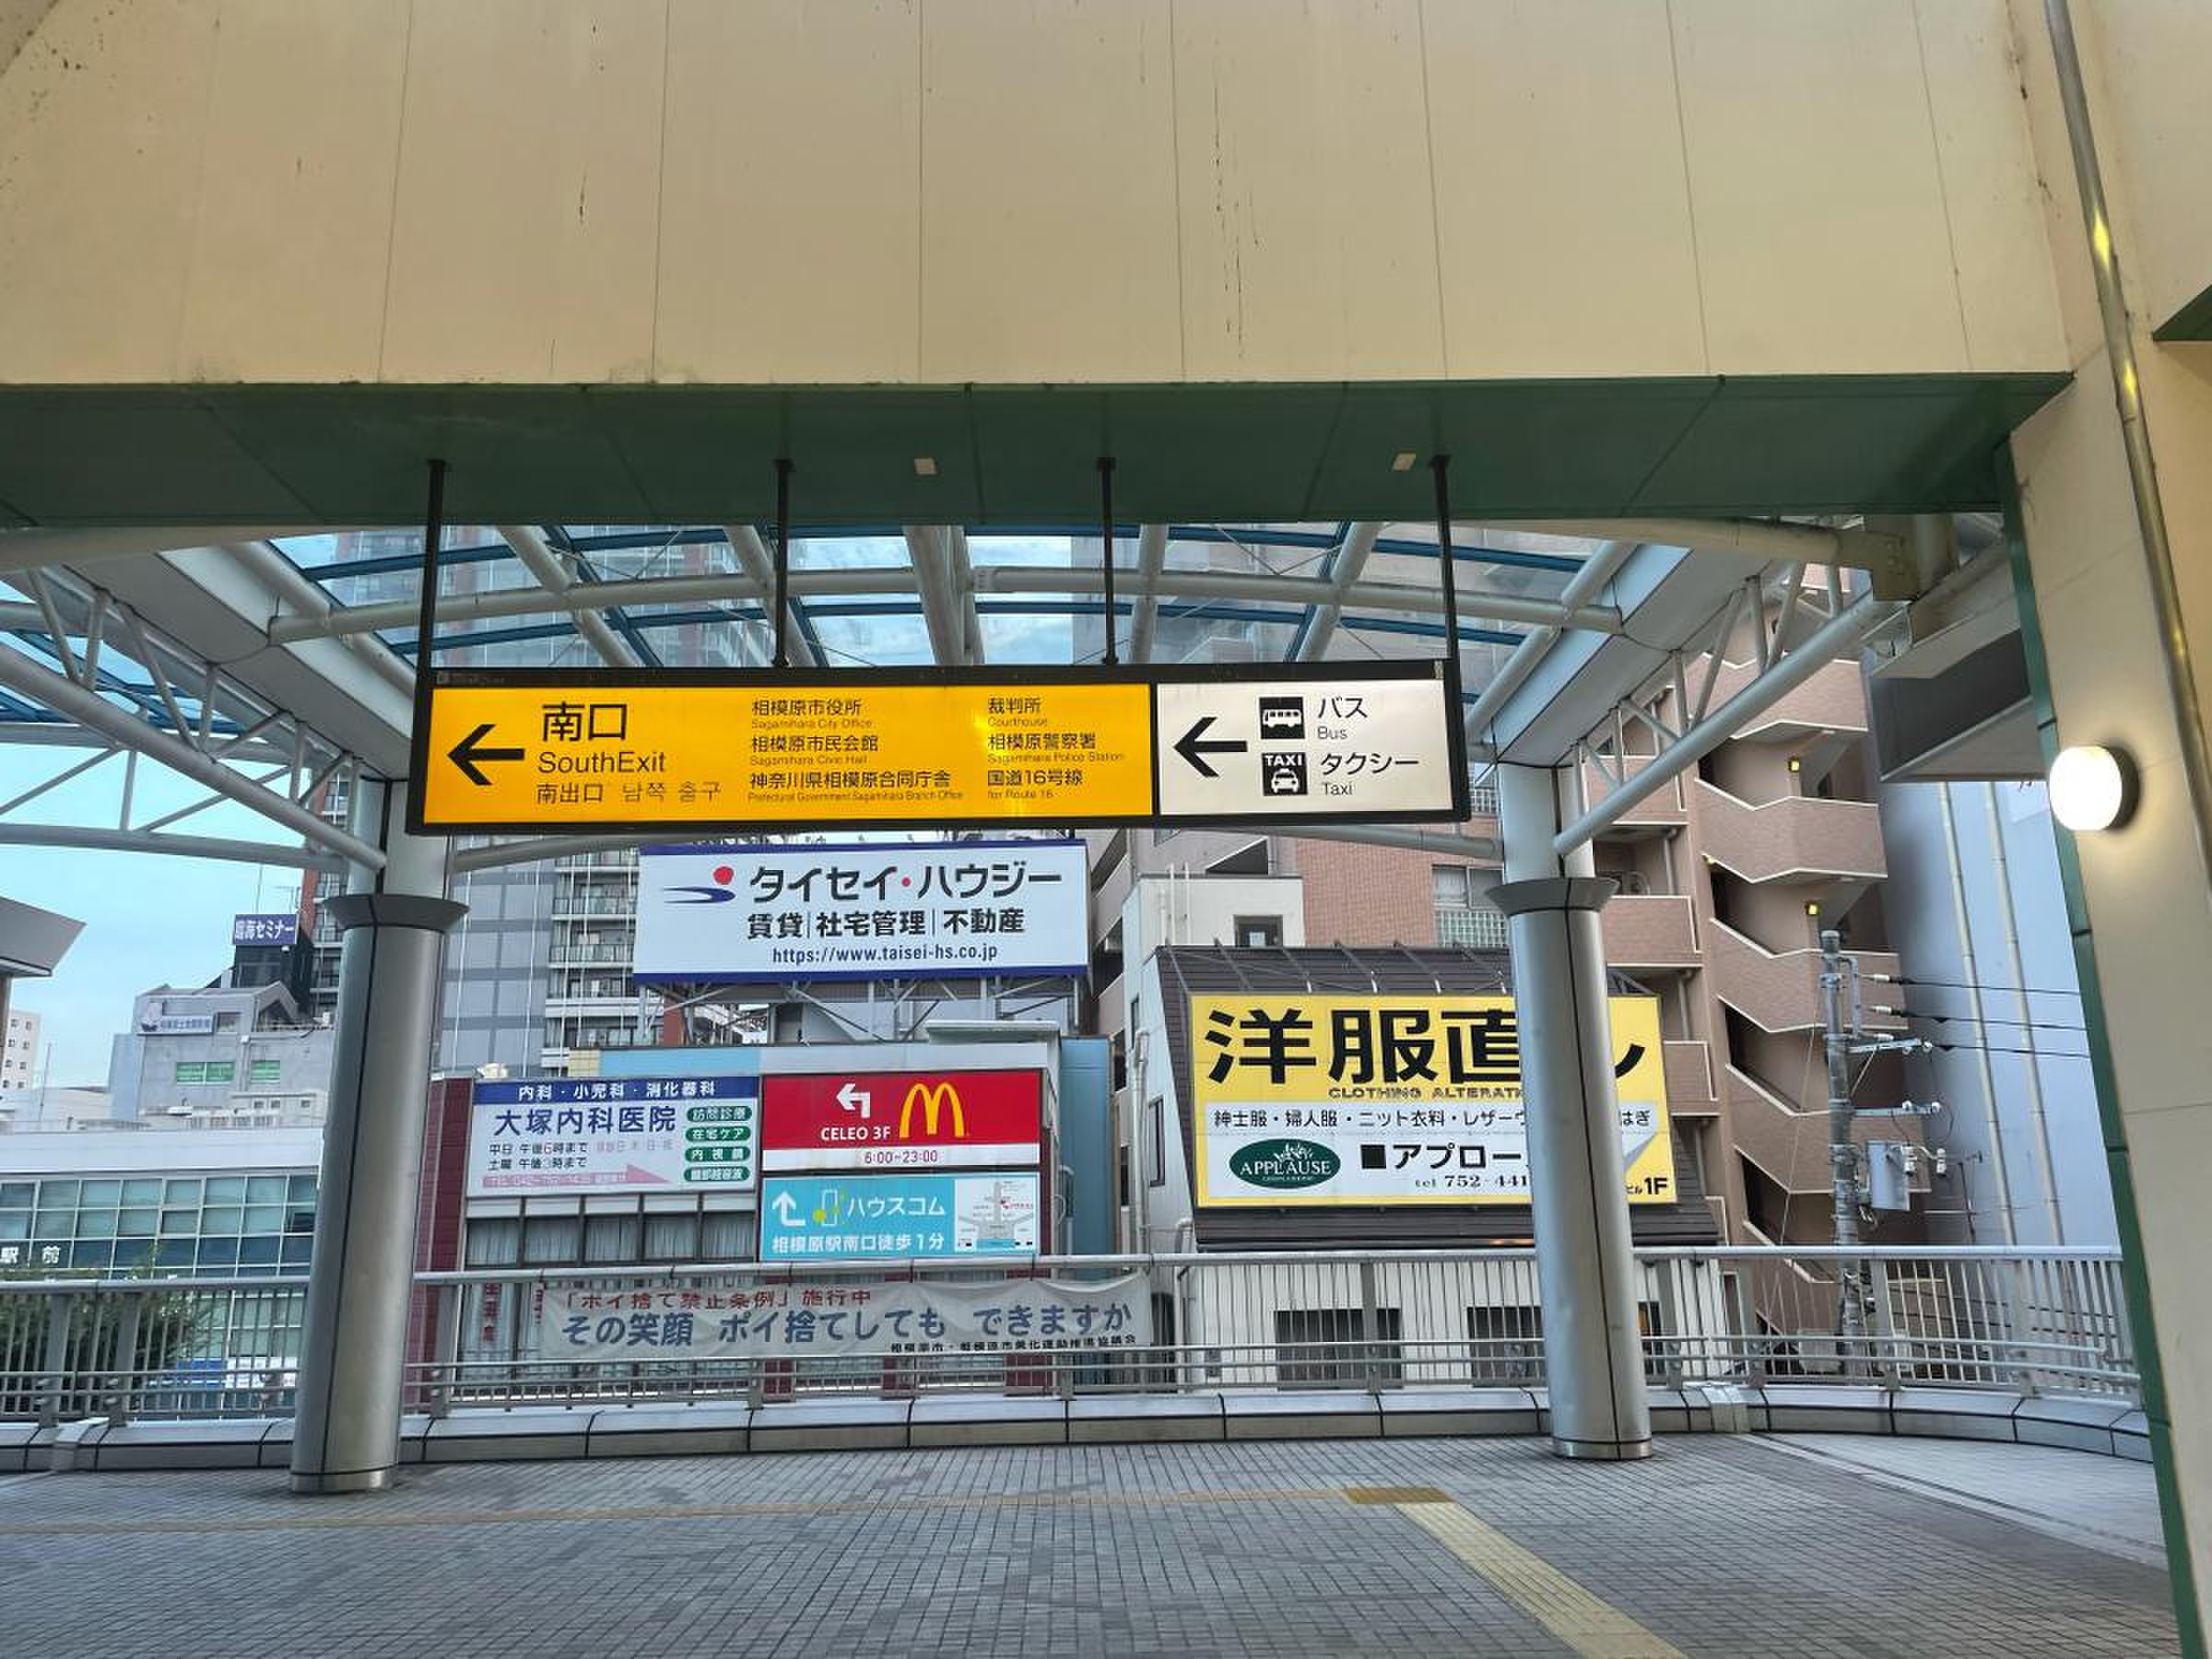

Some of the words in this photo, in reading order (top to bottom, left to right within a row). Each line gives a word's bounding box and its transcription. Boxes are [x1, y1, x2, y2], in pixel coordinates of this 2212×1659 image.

[752, 699, 862, 717] 相模原市役所
[988, 697, 1041, 715] 裁判所
[1318, 697, 1369, 720] バス
[542, 701, 628, 741] 南口
[988, 733, 1096, 750] 相模原警察署
[1318, 726, 1348, 740] Bus
[752, 735, 878, 753] 相模原市民会館
[1265, 755, 1302, 766] TAXI
[1321, 752, 1419, 776] タクシー
[750, 771, 950, 790] 神奈川県相模原合同庁舎
[988, 770, 1083, 786] 国道16号線
[536, 783, 604, 805] 南出口
[1323, 782, 1353, 796] Taxi
[749, 861, 1063, 903] タイセイ・ハウジー
[747, 913, 803, 940] 賃貸
[816, 910, 926, 938] 社宅管理
[943, 907, 1026, 935] 不動産
[771, 943, 998, 965] https://www.taisei-hs.co.jp
[1328, 1088, 1422, 1099] CLOTHING
[493, 1106, 677, 1135] 大塚内科医院
[821, 1126, 869, 1141] CELEO
[873, 1125, 891, 1140] 3F
[1393, 1143, 1528, 1170] アプロー
[1240, 1160, 1332, 1175] APPLAUSE
[1415, 1179, 1437, 1187] tel
[848, 1197, 945, 1218] ハウスコム
[802, 1289, 871, 1306] 施行中
[562, 1312, 694, 1347] その笑顔
[719, 1307, 945, 1343] ポイ捨てしても
[973, 1303, 1132, 1336] できますか
